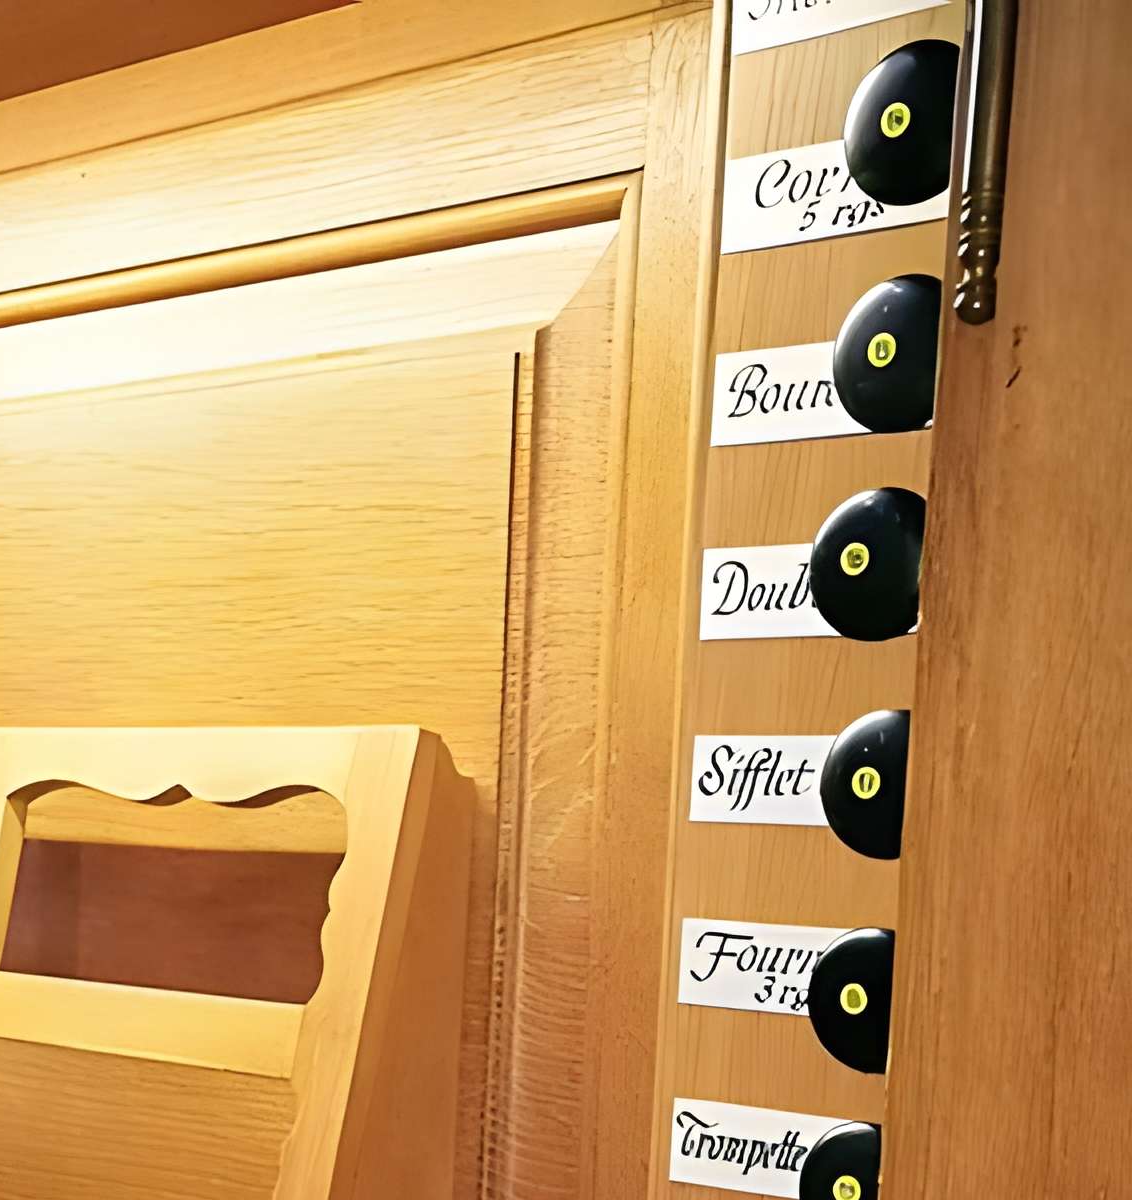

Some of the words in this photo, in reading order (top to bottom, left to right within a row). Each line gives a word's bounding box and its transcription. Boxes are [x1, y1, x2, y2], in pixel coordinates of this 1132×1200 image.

[710, 560, 818, 616] Doub
[698, 744, 816, 812] Sifflet
[753, 975, 776, 1004] 3
